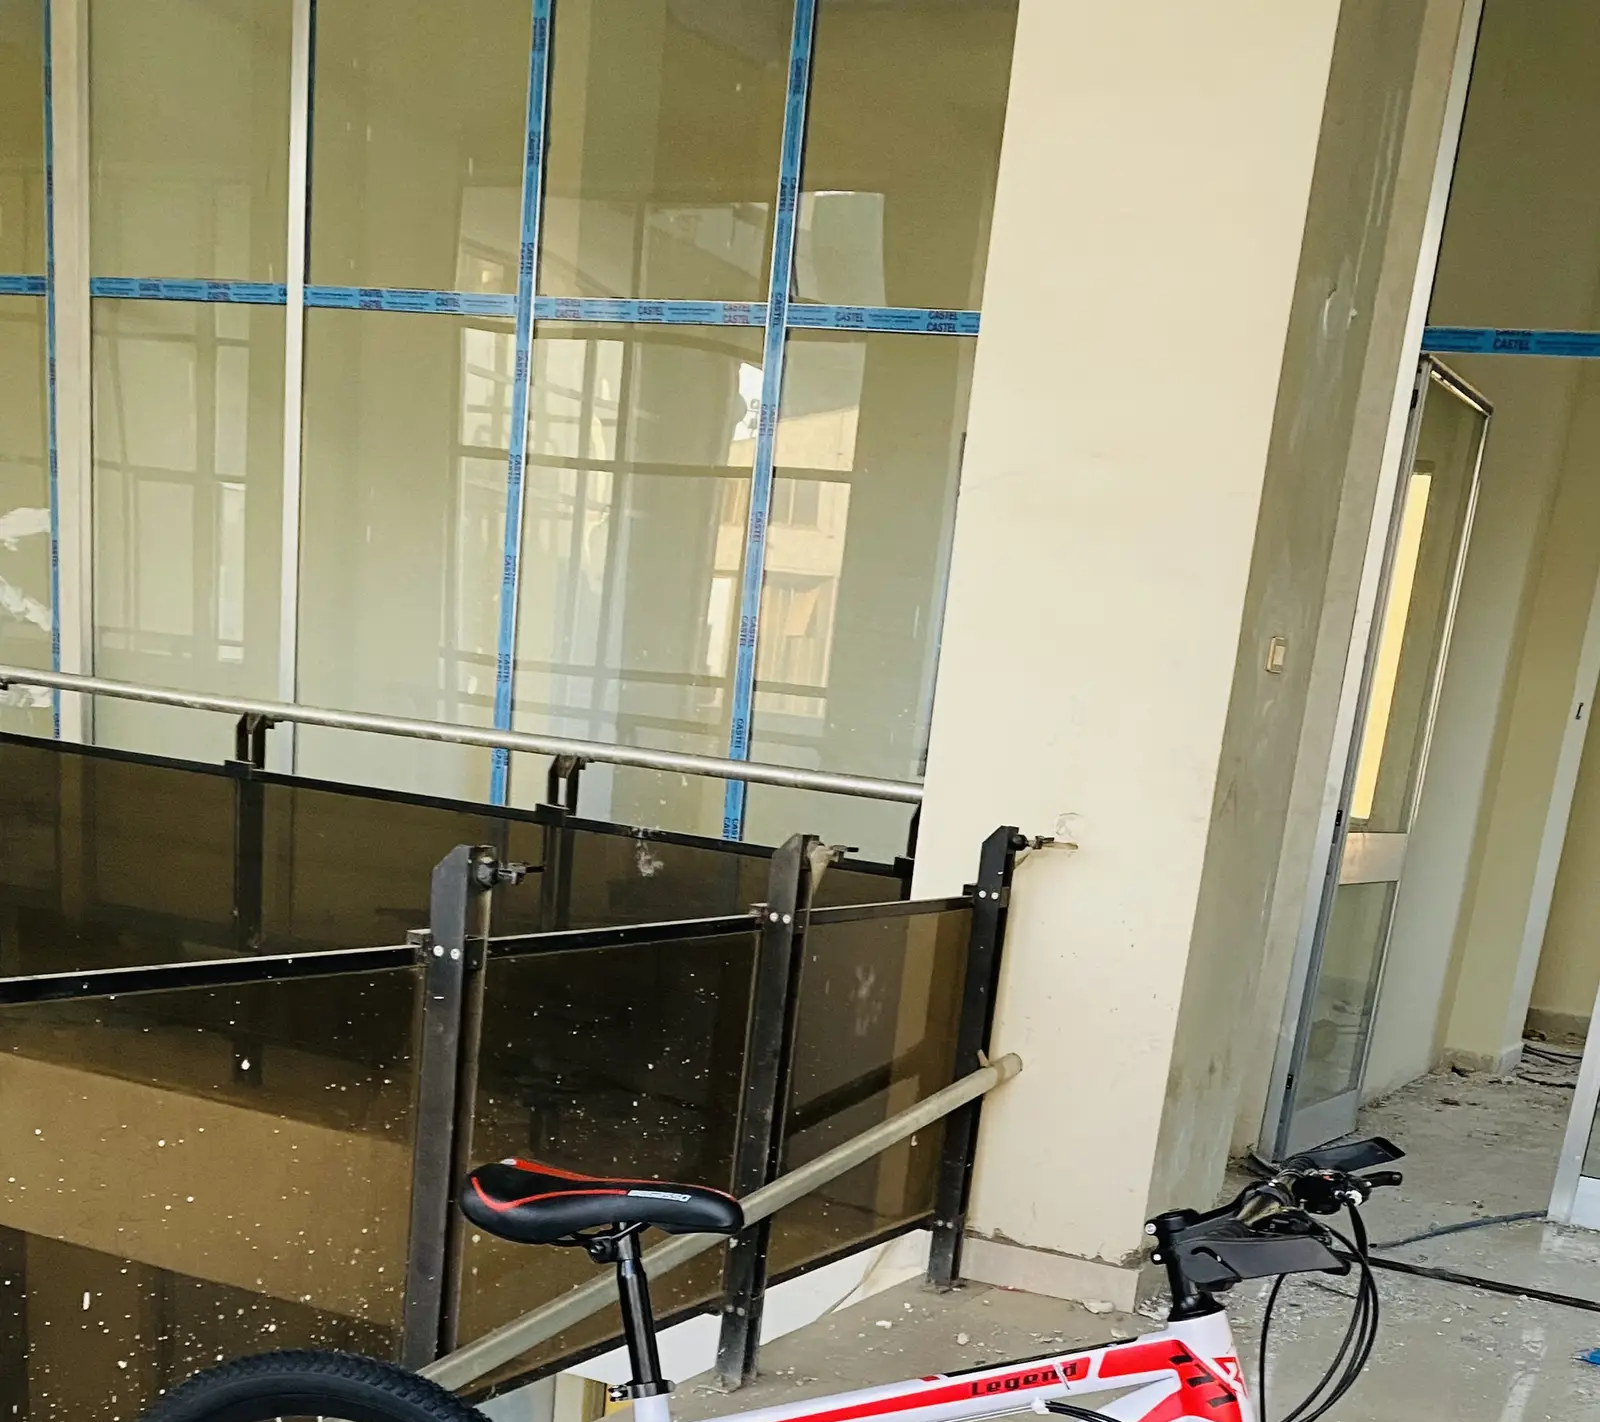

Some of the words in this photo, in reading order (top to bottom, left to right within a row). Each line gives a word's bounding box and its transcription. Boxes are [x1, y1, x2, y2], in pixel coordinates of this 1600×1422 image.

[834, 311, 864, 323] CASTEL
[926, 321, 957, 332] CASTEL
[733, 718, 744, 749] CASTEL
[971, 1362, 1078, 1396] Legend
